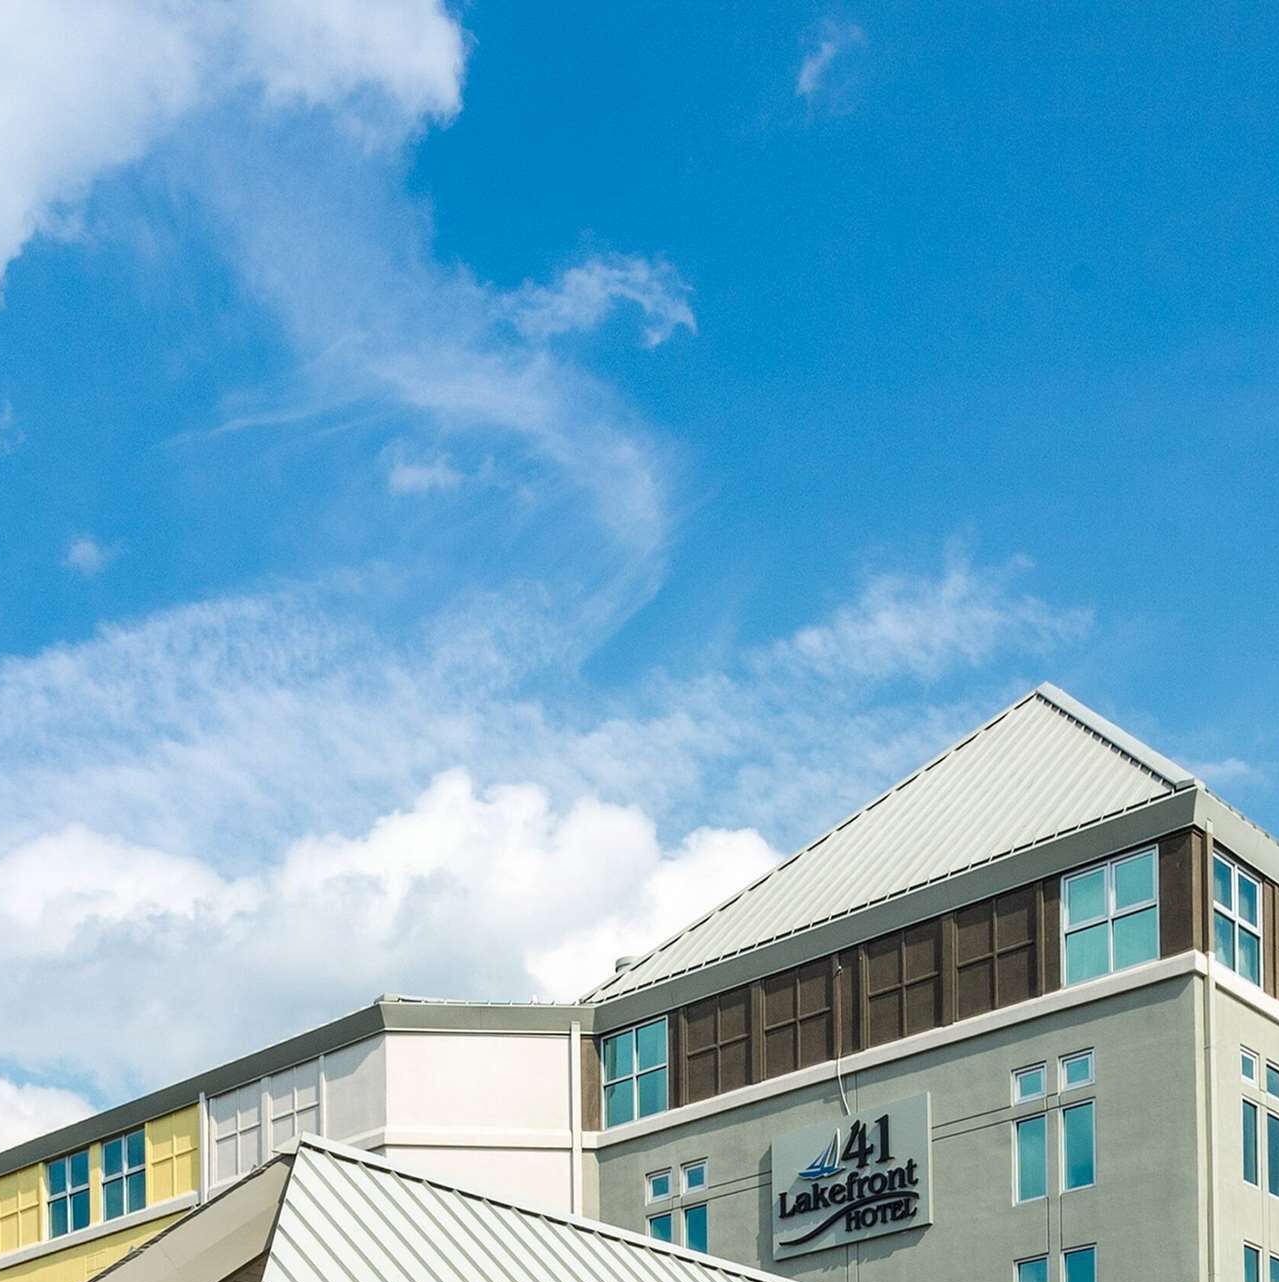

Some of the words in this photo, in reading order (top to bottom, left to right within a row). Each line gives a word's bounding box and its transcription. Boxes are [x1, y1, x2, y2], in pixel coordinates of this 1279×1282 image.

[841, 1114, 895, 1168] 41
[779, 1158, 919, 1218] Lakefront
[845, 1199, 918, 1232] HOTEL
